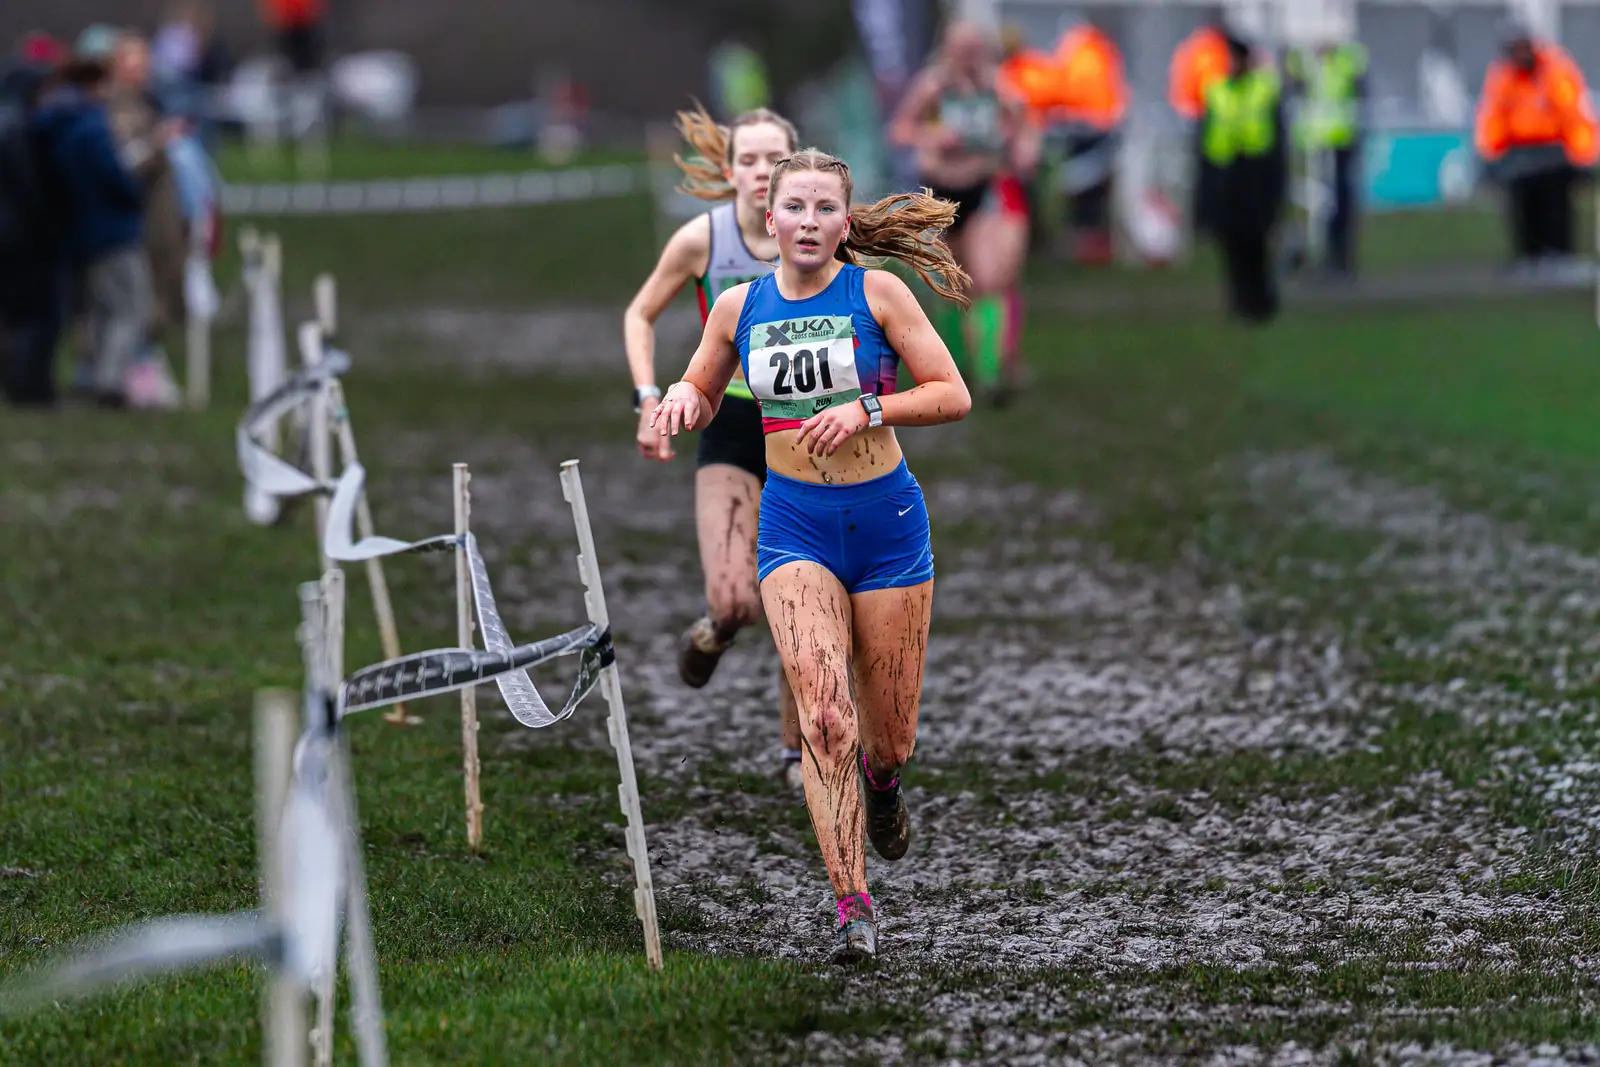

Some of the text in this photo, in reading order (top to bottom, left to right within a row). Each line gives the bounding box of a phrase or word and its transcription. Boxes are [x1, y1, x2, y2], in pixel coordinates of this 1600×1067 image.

[791, 329, 835, 341] CROSS CHALLENGE
[769, 347, 834, 396] 201
[815, 396, 832, 407] RUN
